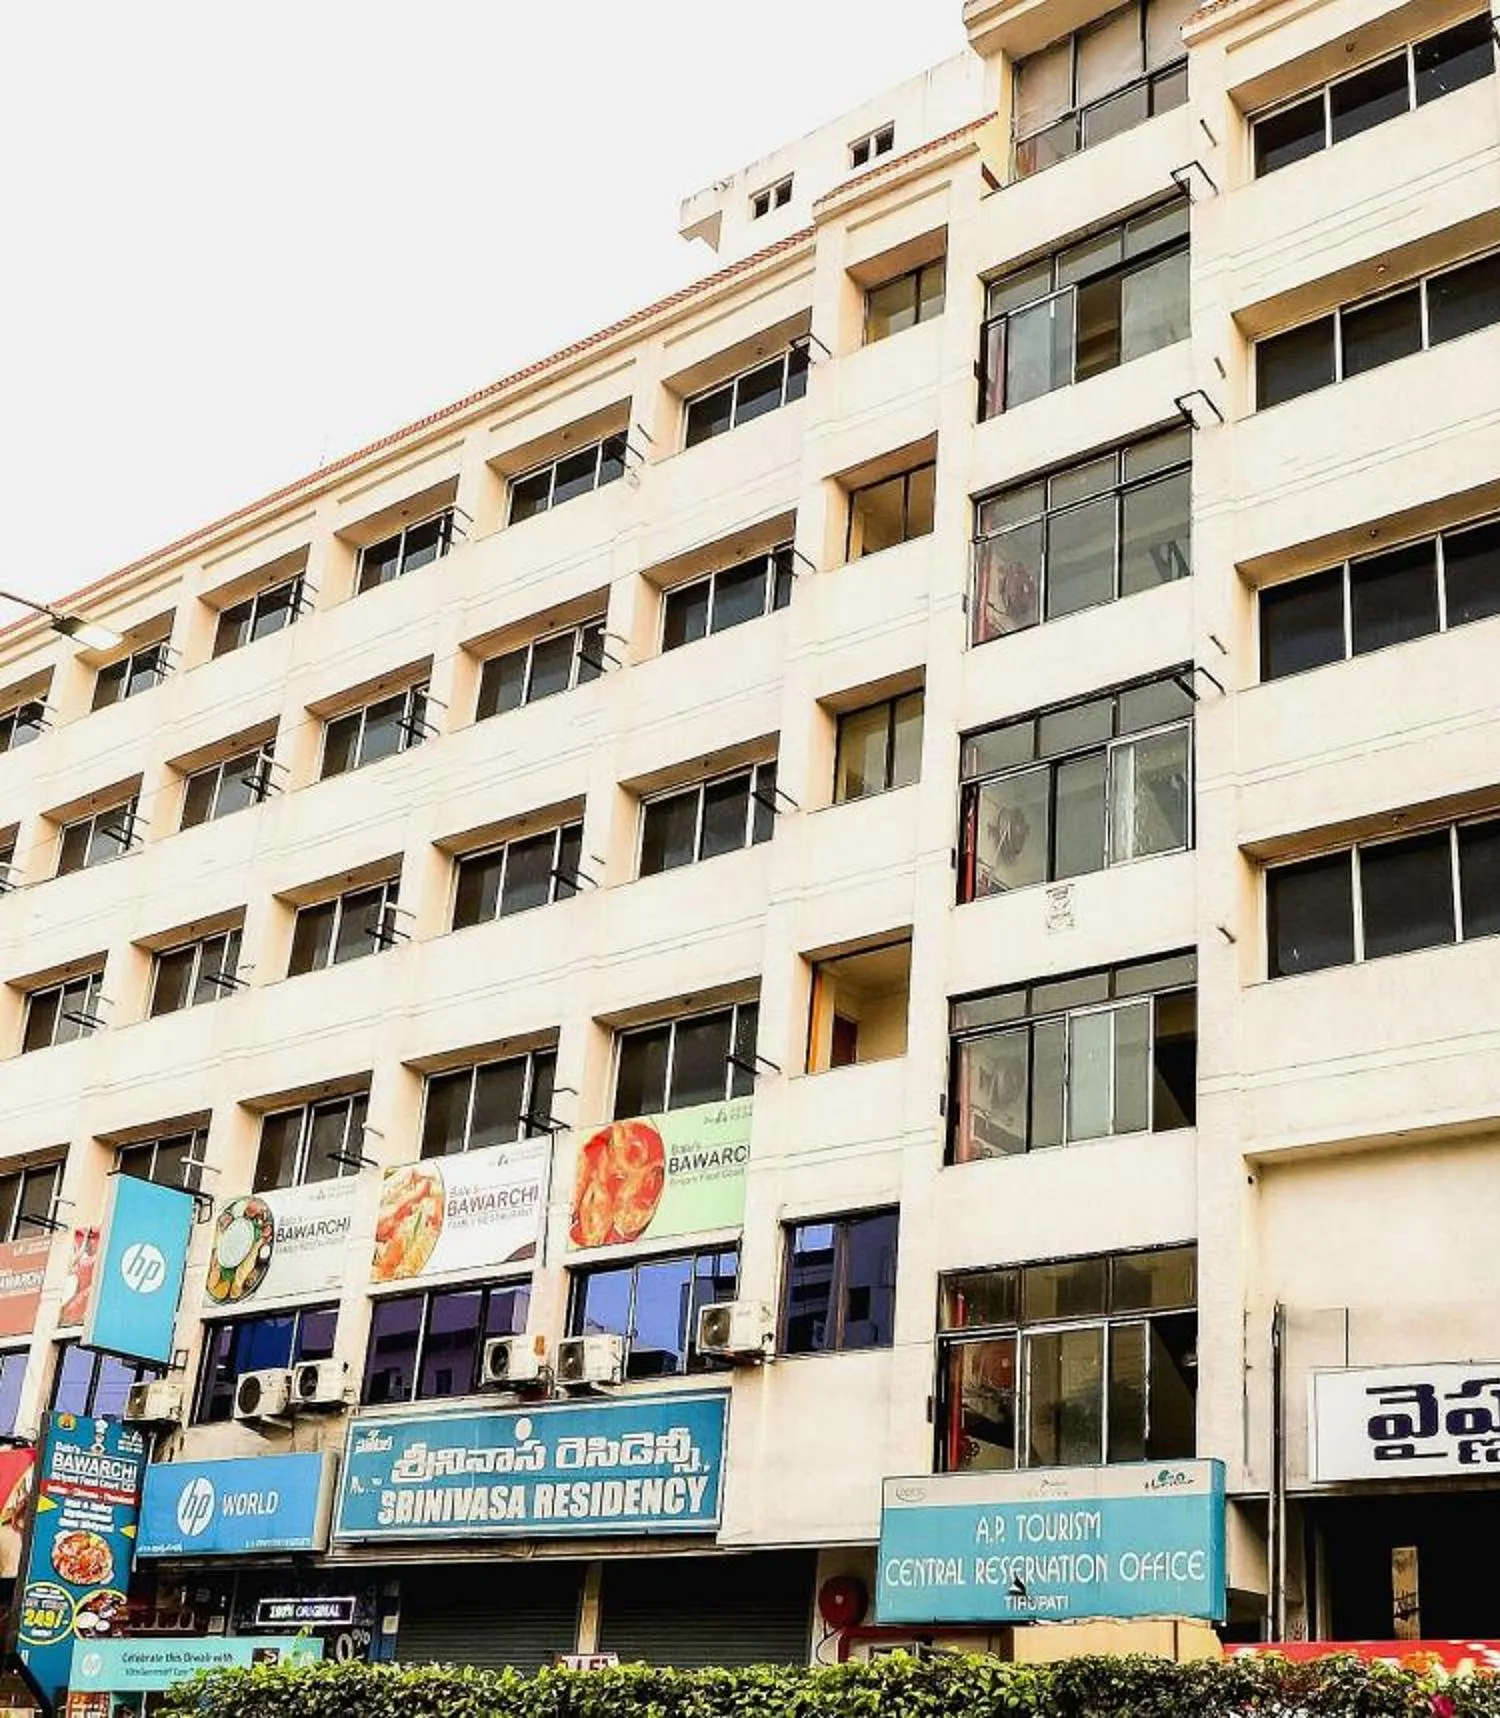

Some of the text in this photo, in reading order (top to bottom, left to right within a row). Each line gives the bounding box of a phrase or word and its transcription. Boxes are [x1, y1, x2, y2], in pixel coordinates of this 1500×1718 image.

[447, 1184, 539, 1217] BAWARCHI
[276, 1215, 351, 1243] BAWARCHI
[121, 1242, 167, 1294] hp
[53, 1451, 137, 1480] BAWARCHI
[177, 1477, 215, 1537] hp
[223, 1491, 279, 1516] WORLD
[378, 1485, 526, 1525] SRINIVASA
[533, 1476, 709, 1519] RESIDENCY
[975, 1511, 1101, 1544] A.P. TOURISM
[885, 1550, 1206, 1588] CENTRAL RESERVATION OFFICE
[1004, 1595, 1070, 1611] TIRUPATI
